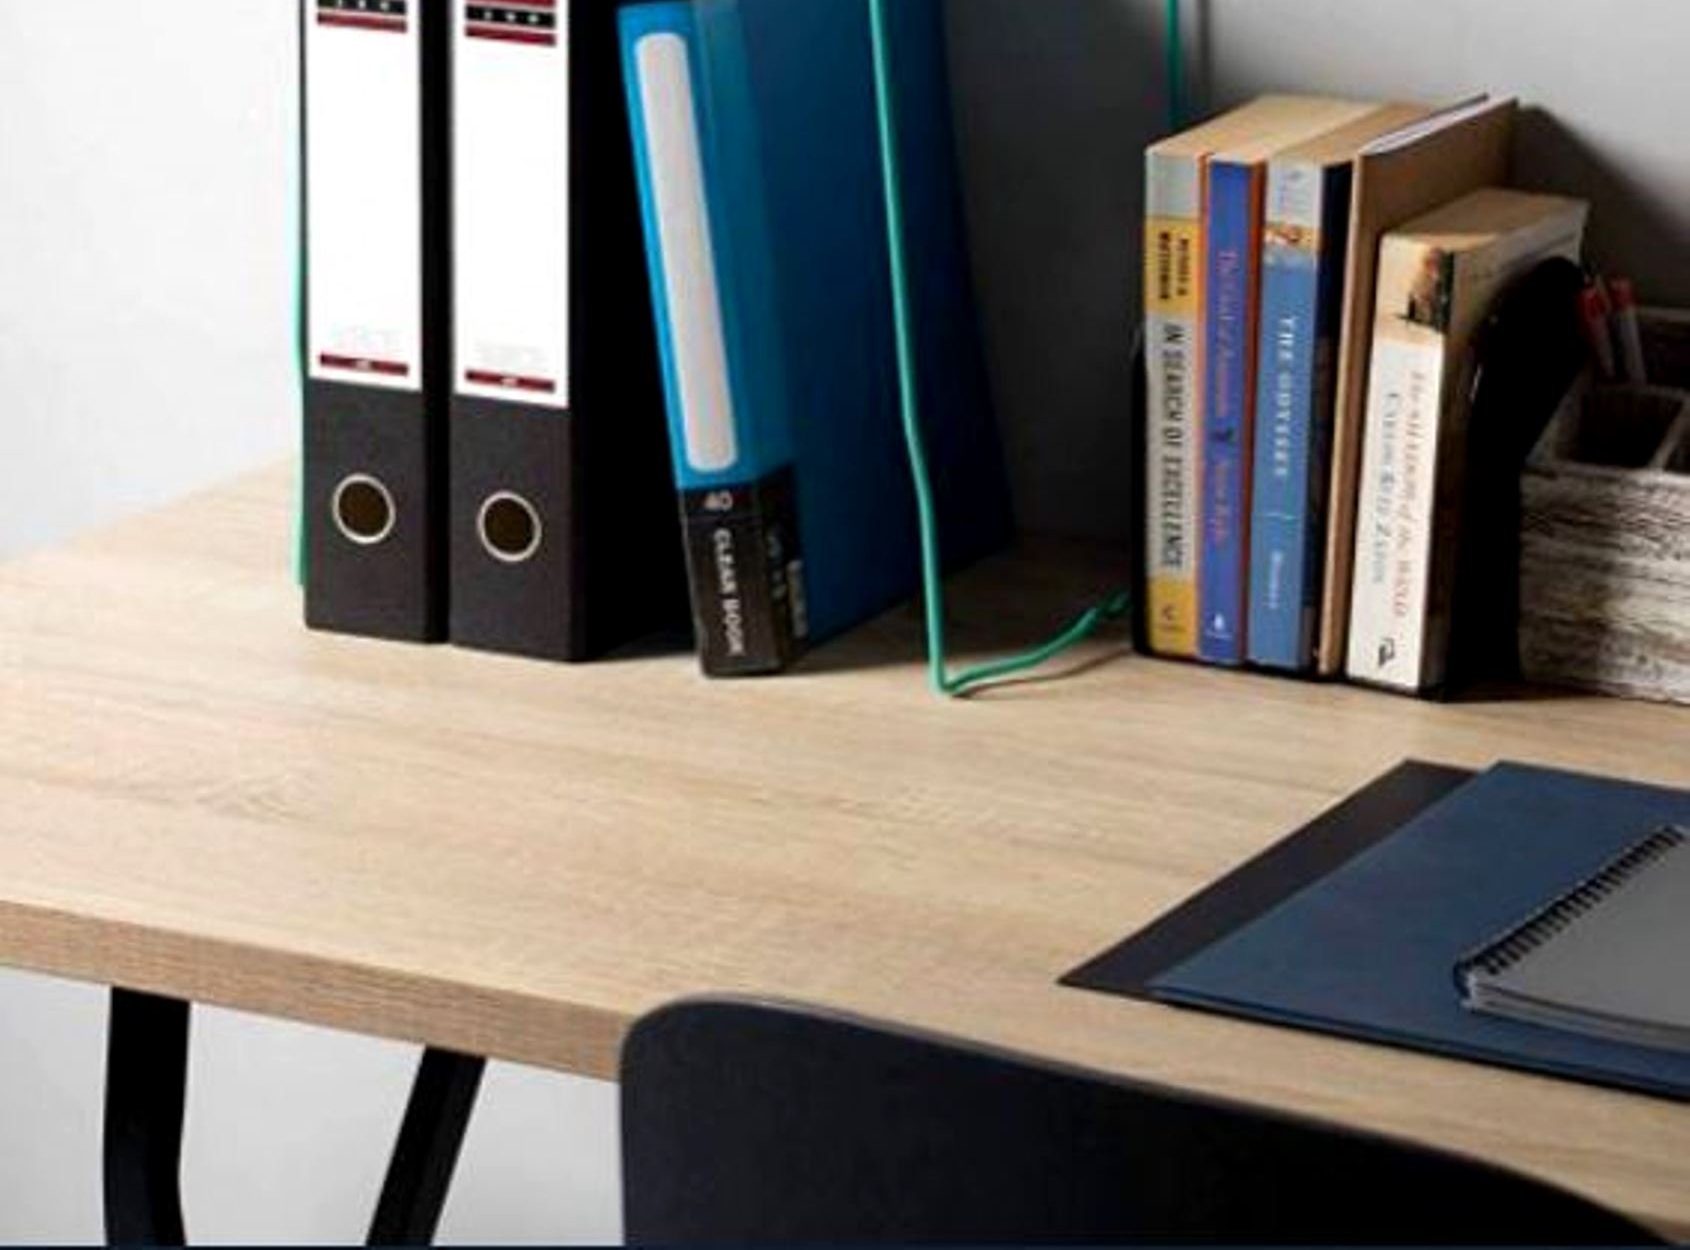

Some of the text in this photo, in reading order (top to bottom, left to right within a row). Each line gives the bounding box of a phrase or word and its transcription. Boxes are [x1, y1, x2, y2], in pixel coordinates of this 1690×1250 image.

[1162, 324, 1185, 567] IN SEARCH OF EXCELLENCE
[1273, 316, 1296, 476] THE ODYSSEY
[714, 528, 738, 595] CLEAR
[722, 599, 745, 656] BOOK
